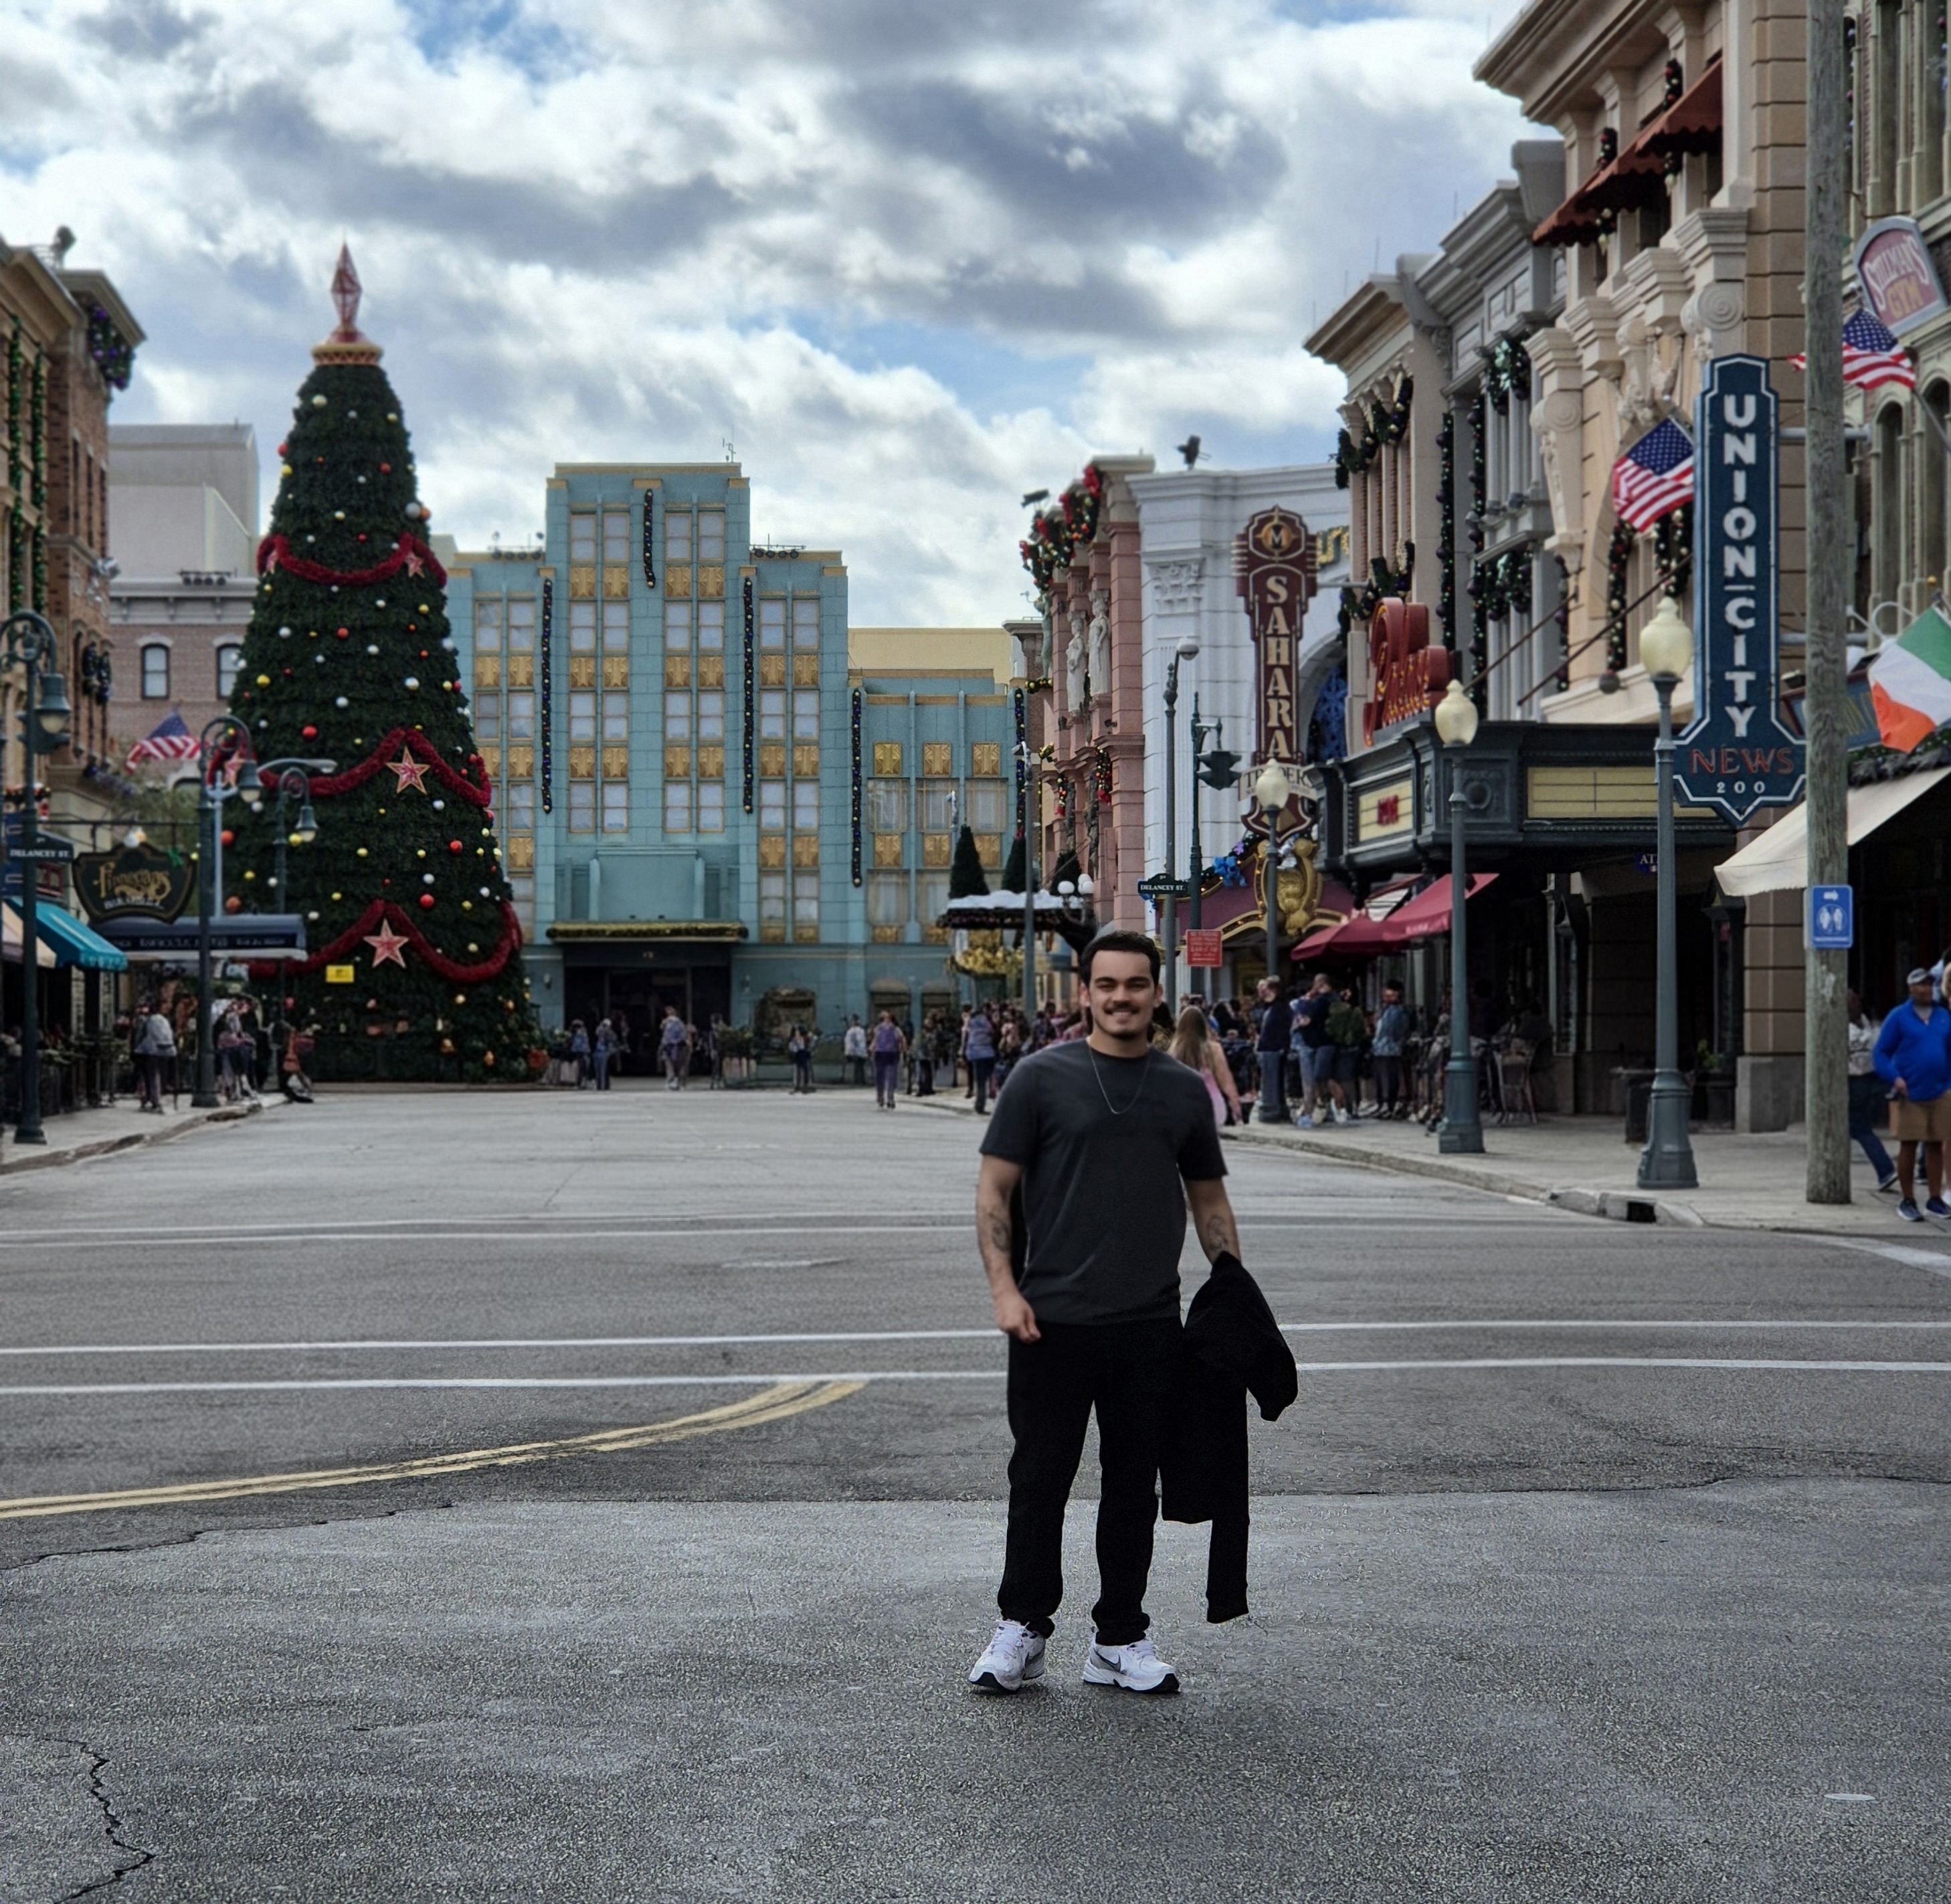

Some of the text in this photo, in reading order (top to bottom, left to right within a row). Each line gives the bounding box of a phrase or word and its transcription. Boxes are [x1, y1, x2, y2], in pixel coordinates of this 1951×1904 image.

[1885, 274, 1925, 320] GYM
[1265, 575, 1293, 759] SAHARA
[1690, 747, 1794, 775] NEWS
[1716, 780, 1766, 794] 200
[1639, 854, 1659, 864] AT
